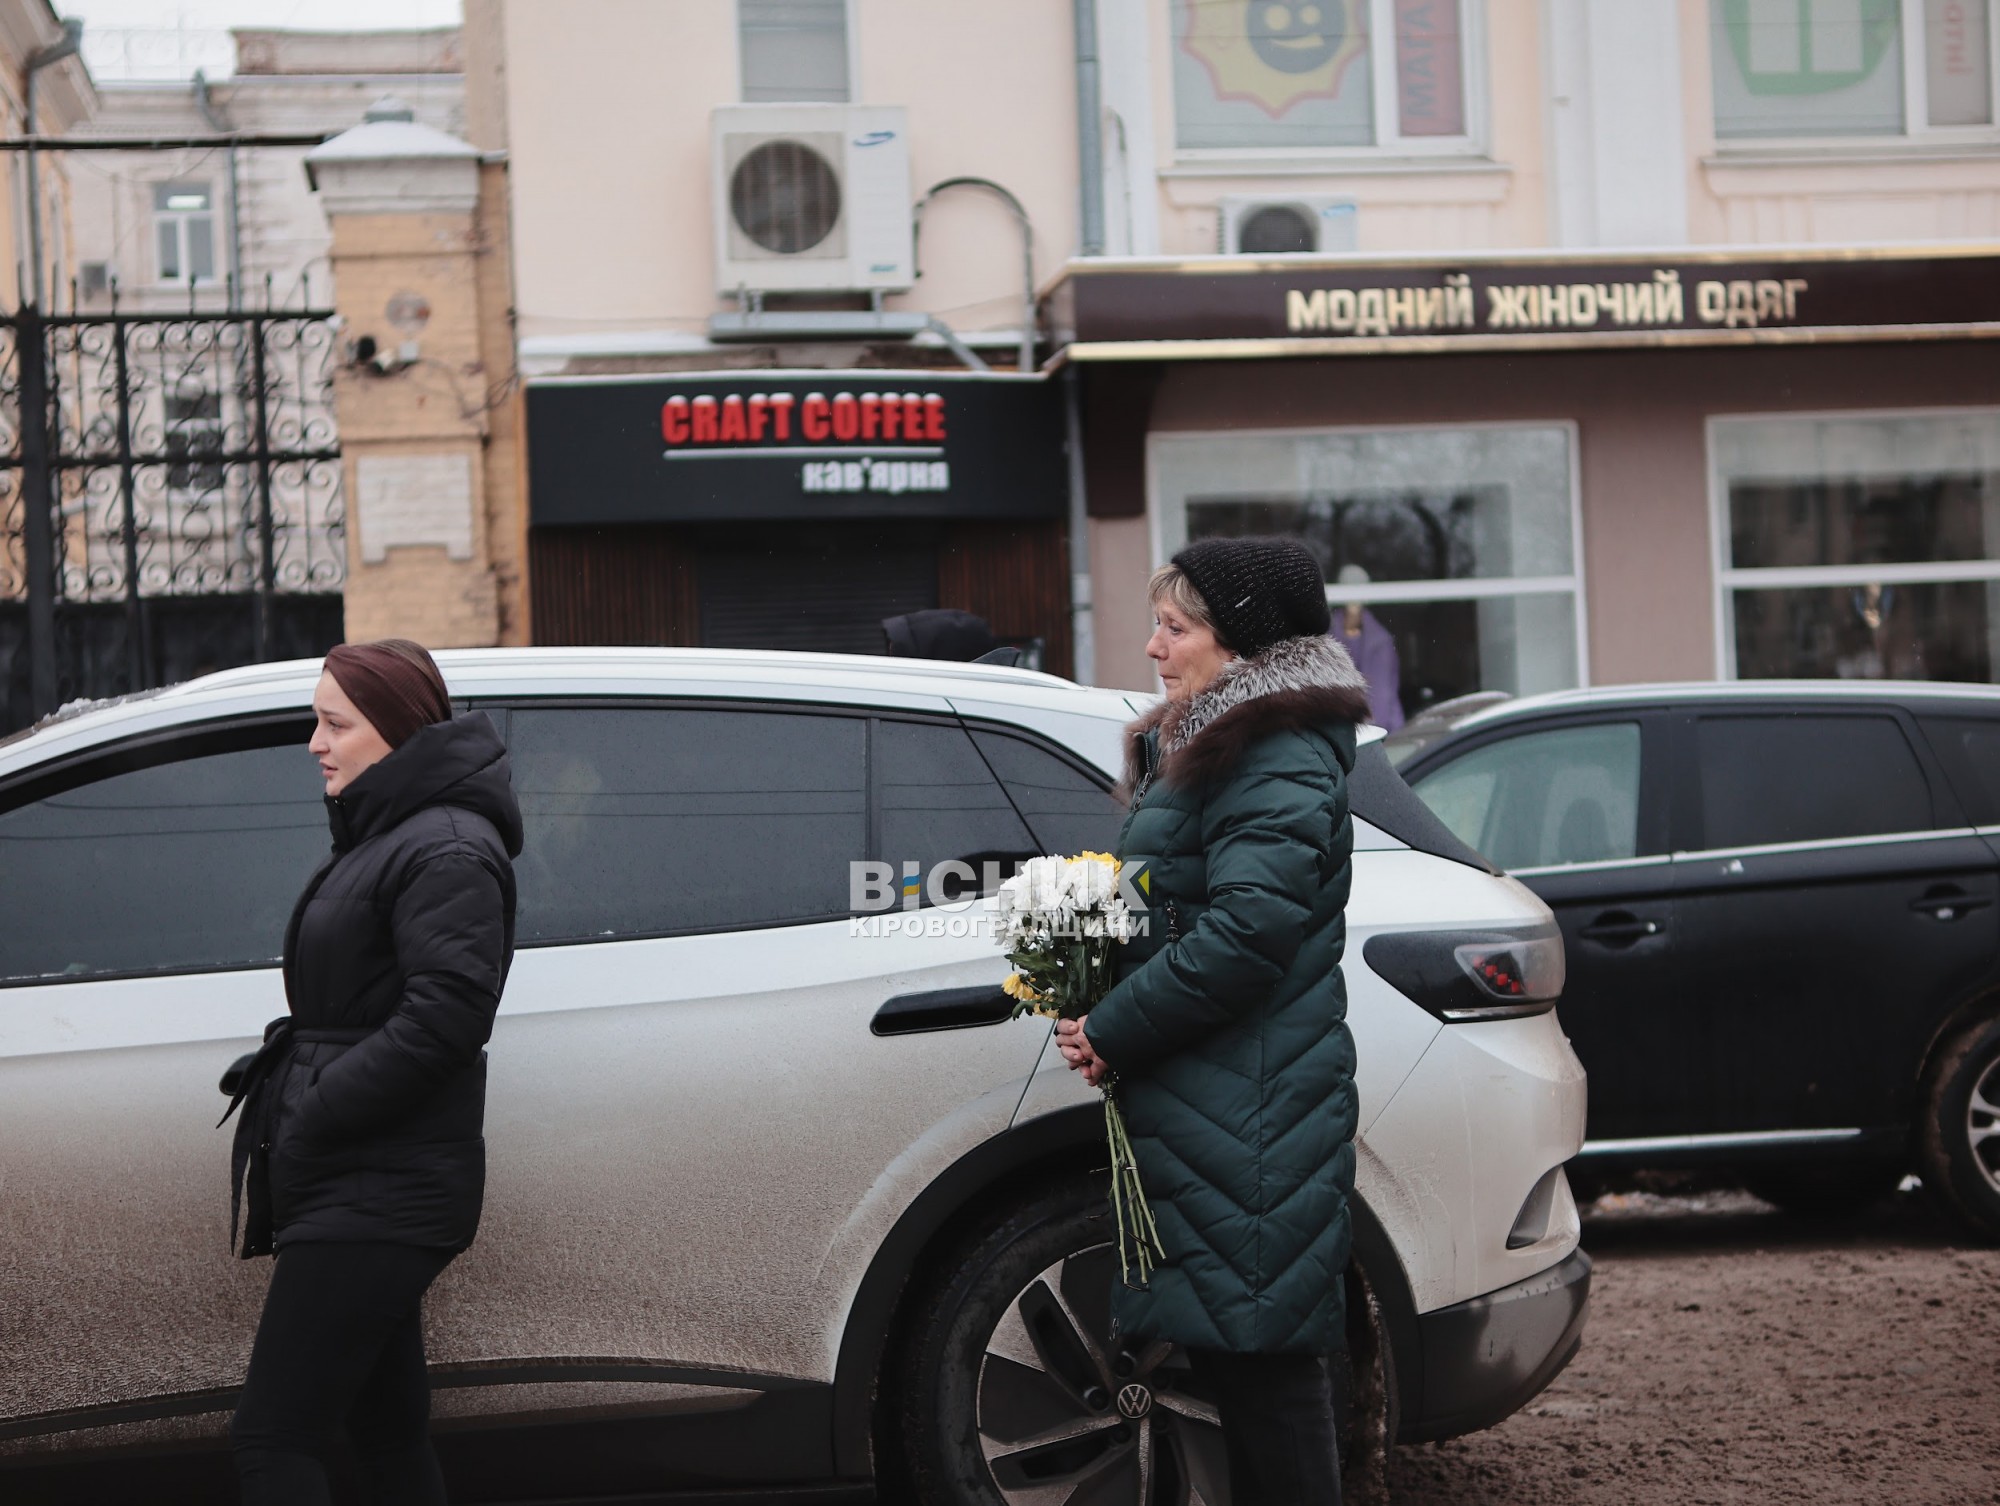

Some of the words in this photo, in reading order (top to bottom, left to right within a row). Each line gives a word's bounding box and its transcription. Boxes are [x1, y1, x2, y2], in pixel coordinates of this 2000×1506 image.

[1287, 273, 1475, 336] МОДНИЙ
[1486, 269, 1684, 327] ЖІНОЧИЙ
[1696, 278, 1809, 328] ОДЯГ
[661, 392, 795, 444] CRAFT
[802, 391, 947, 440] COFFEE
[802, 457, 949, 495] кав'ярня
